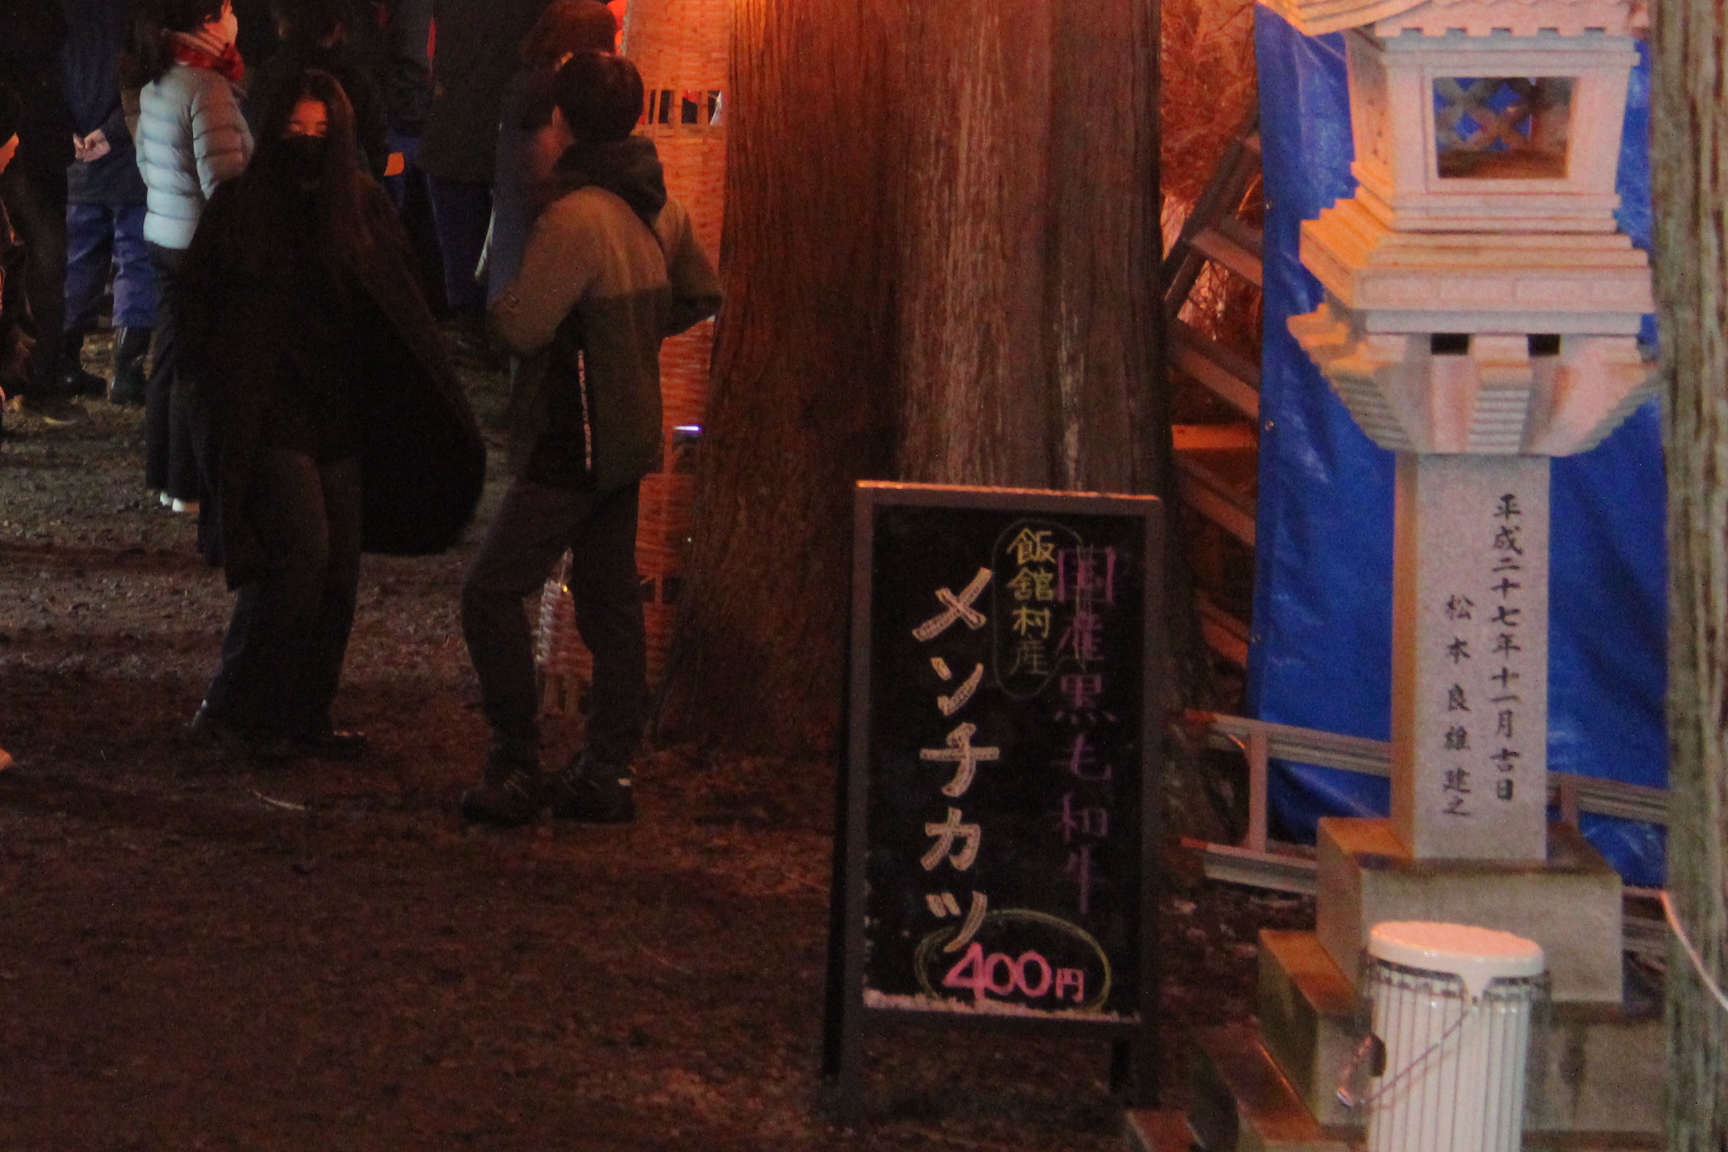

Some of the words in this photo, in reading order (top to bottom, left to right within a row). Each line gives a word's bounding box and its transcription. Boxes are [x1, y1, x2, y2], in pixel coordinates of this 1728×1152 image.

[912, 566, 1000, 954] メンチカツ
[1051, 544, 1117, 914] 国産黒毛和牛
[1489, 493, 1523, 801] 平成二十七年十一月吉日
[943, 943, 1085, 1007] 400円
